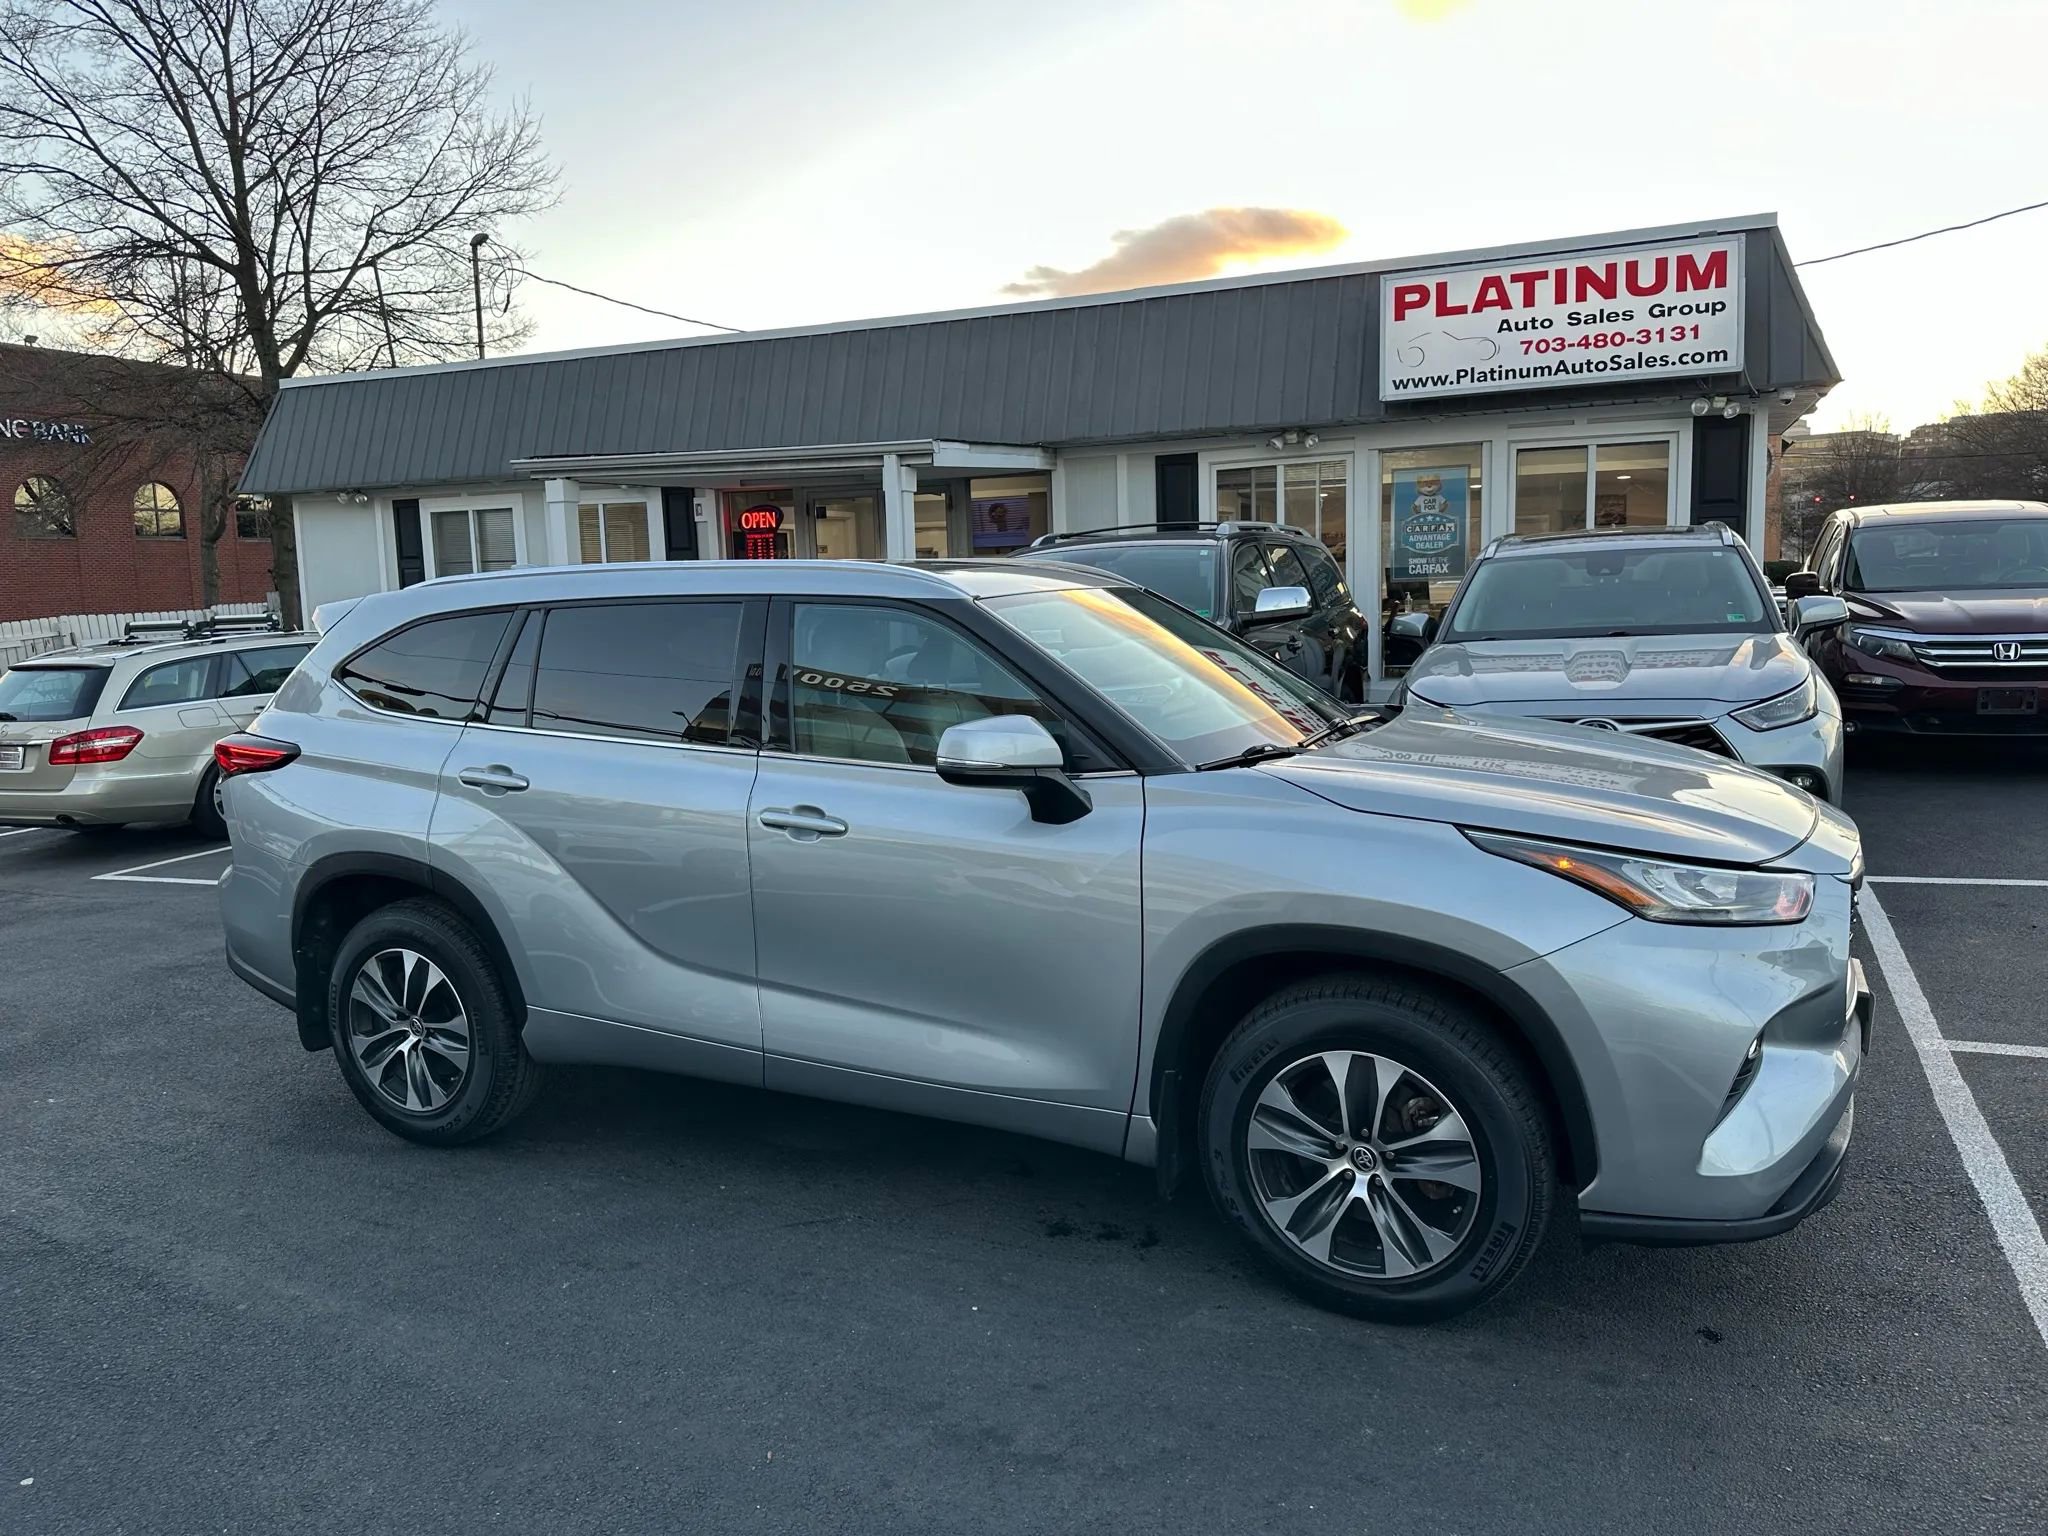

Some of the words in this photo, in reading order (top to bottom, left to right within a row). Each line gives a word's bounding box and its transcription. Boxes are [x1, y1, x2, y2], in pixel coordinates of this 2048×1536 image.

[1394, 250, 1727, 321] PLATINUM
[1497, 316, 1554, 334] Auto
[1567, 308, 1635, 327] Sales
[1649, 300, 1727, 318] Group
[1519, 323, 1700, 356] 703-480-3131
[1391, 348, 1729, 391] www.PlatinumAutoSales.com
[741, 511, 776, 529] OPEN
[1406, 523, 1455, 533] CARFAX
[1409, 533, 1451, 542] ADVANTAGE
[1415, 541, 1444, 550] DEALER
[1408, 563, 1449, 575] CARFAX
